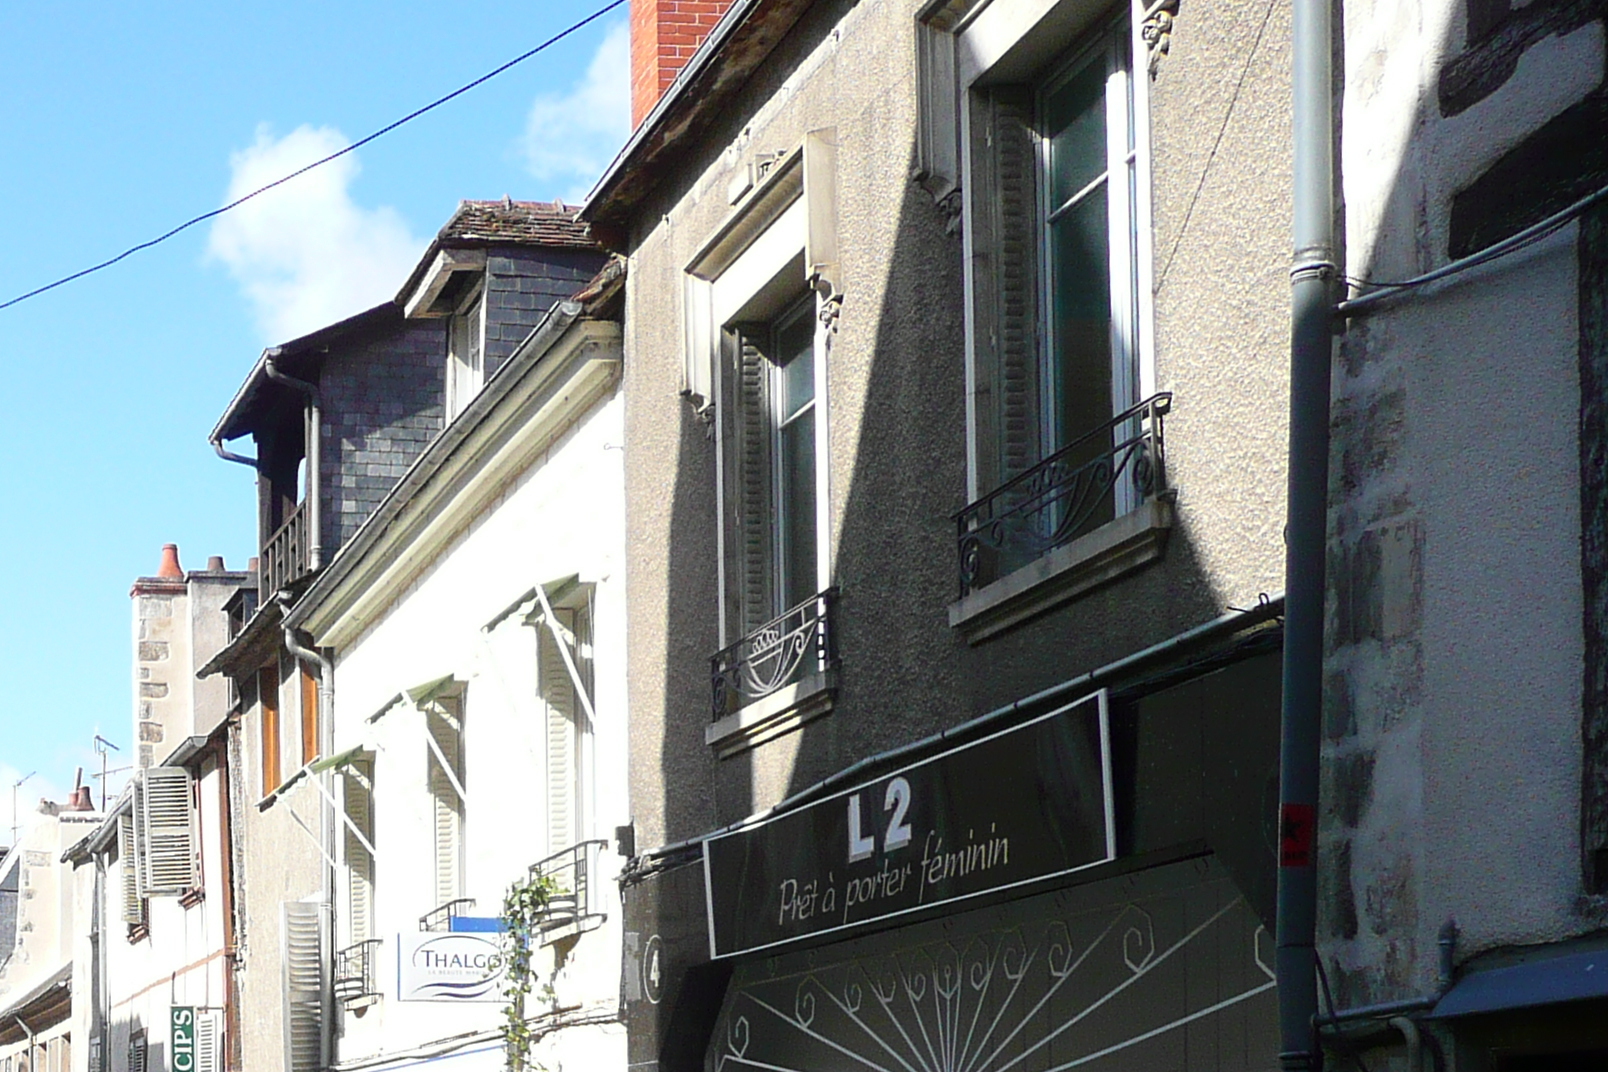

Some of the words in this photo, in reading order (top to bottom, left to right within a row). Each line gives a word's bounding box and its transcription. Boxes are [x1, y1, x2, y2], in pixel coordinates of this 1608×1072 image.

[778, 876, 818, 925] Prêt
[822, 874, 837, 912] à
[844, 862, 912, 925] porter
[921, 823, 1009, 903] féminin
[420, 949, 503, 969] THALGO
[650, 951, 661, 987] 4
